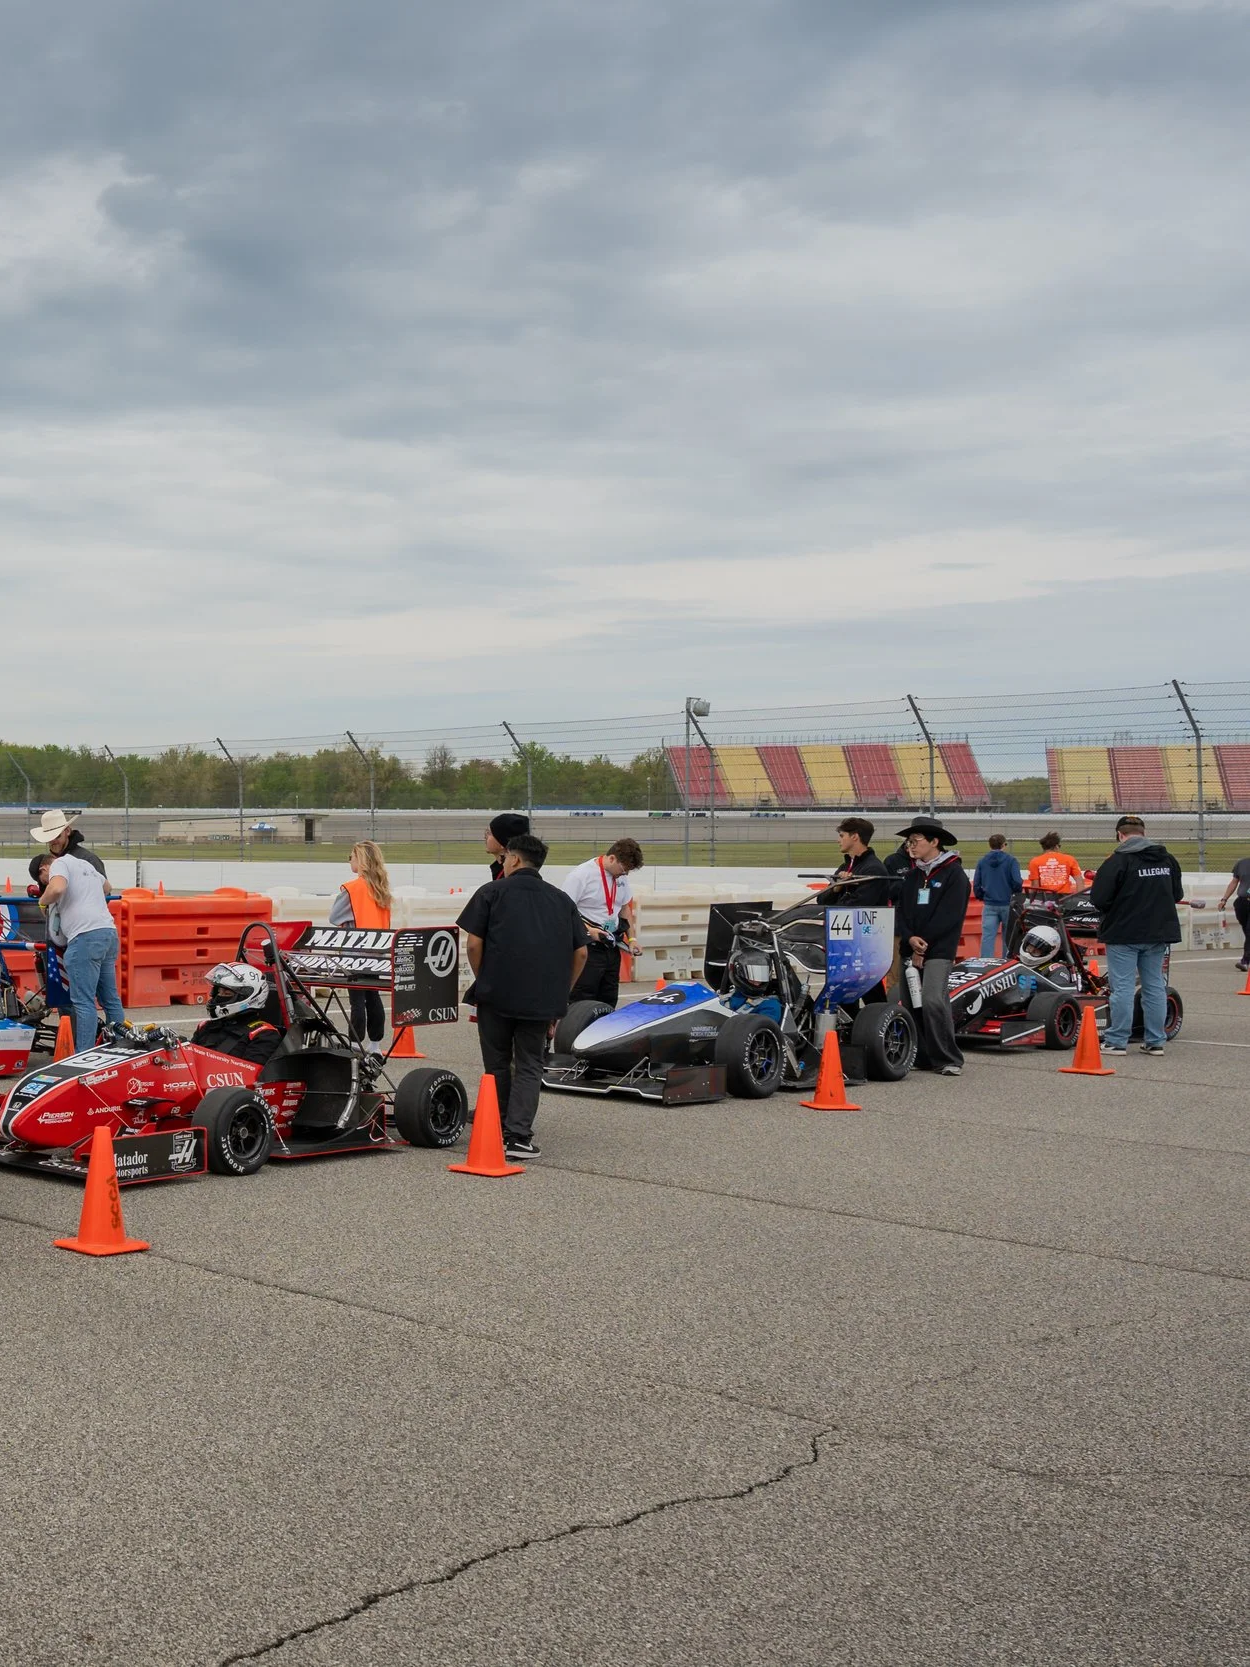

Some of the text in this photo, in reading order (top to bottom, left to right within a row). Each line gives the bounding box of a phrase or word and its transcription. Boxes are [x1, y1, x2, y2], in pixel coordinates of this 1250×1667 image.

[830, 910, 878, 936] 44 UNF
[305, 929, 396, 950] MATAD
[249, 971, 260, 982] 91
[978, 972, 1018, 1000] WASHU
[428, 1006, 458, 1022] CSUN
[206, 1051, 230, 1063] University
[206, 1071, 244, 1088] CSUN
[94, 1105, 123, 1114] ANDURIL
[115, 1165, 149, 1178] otorsports
